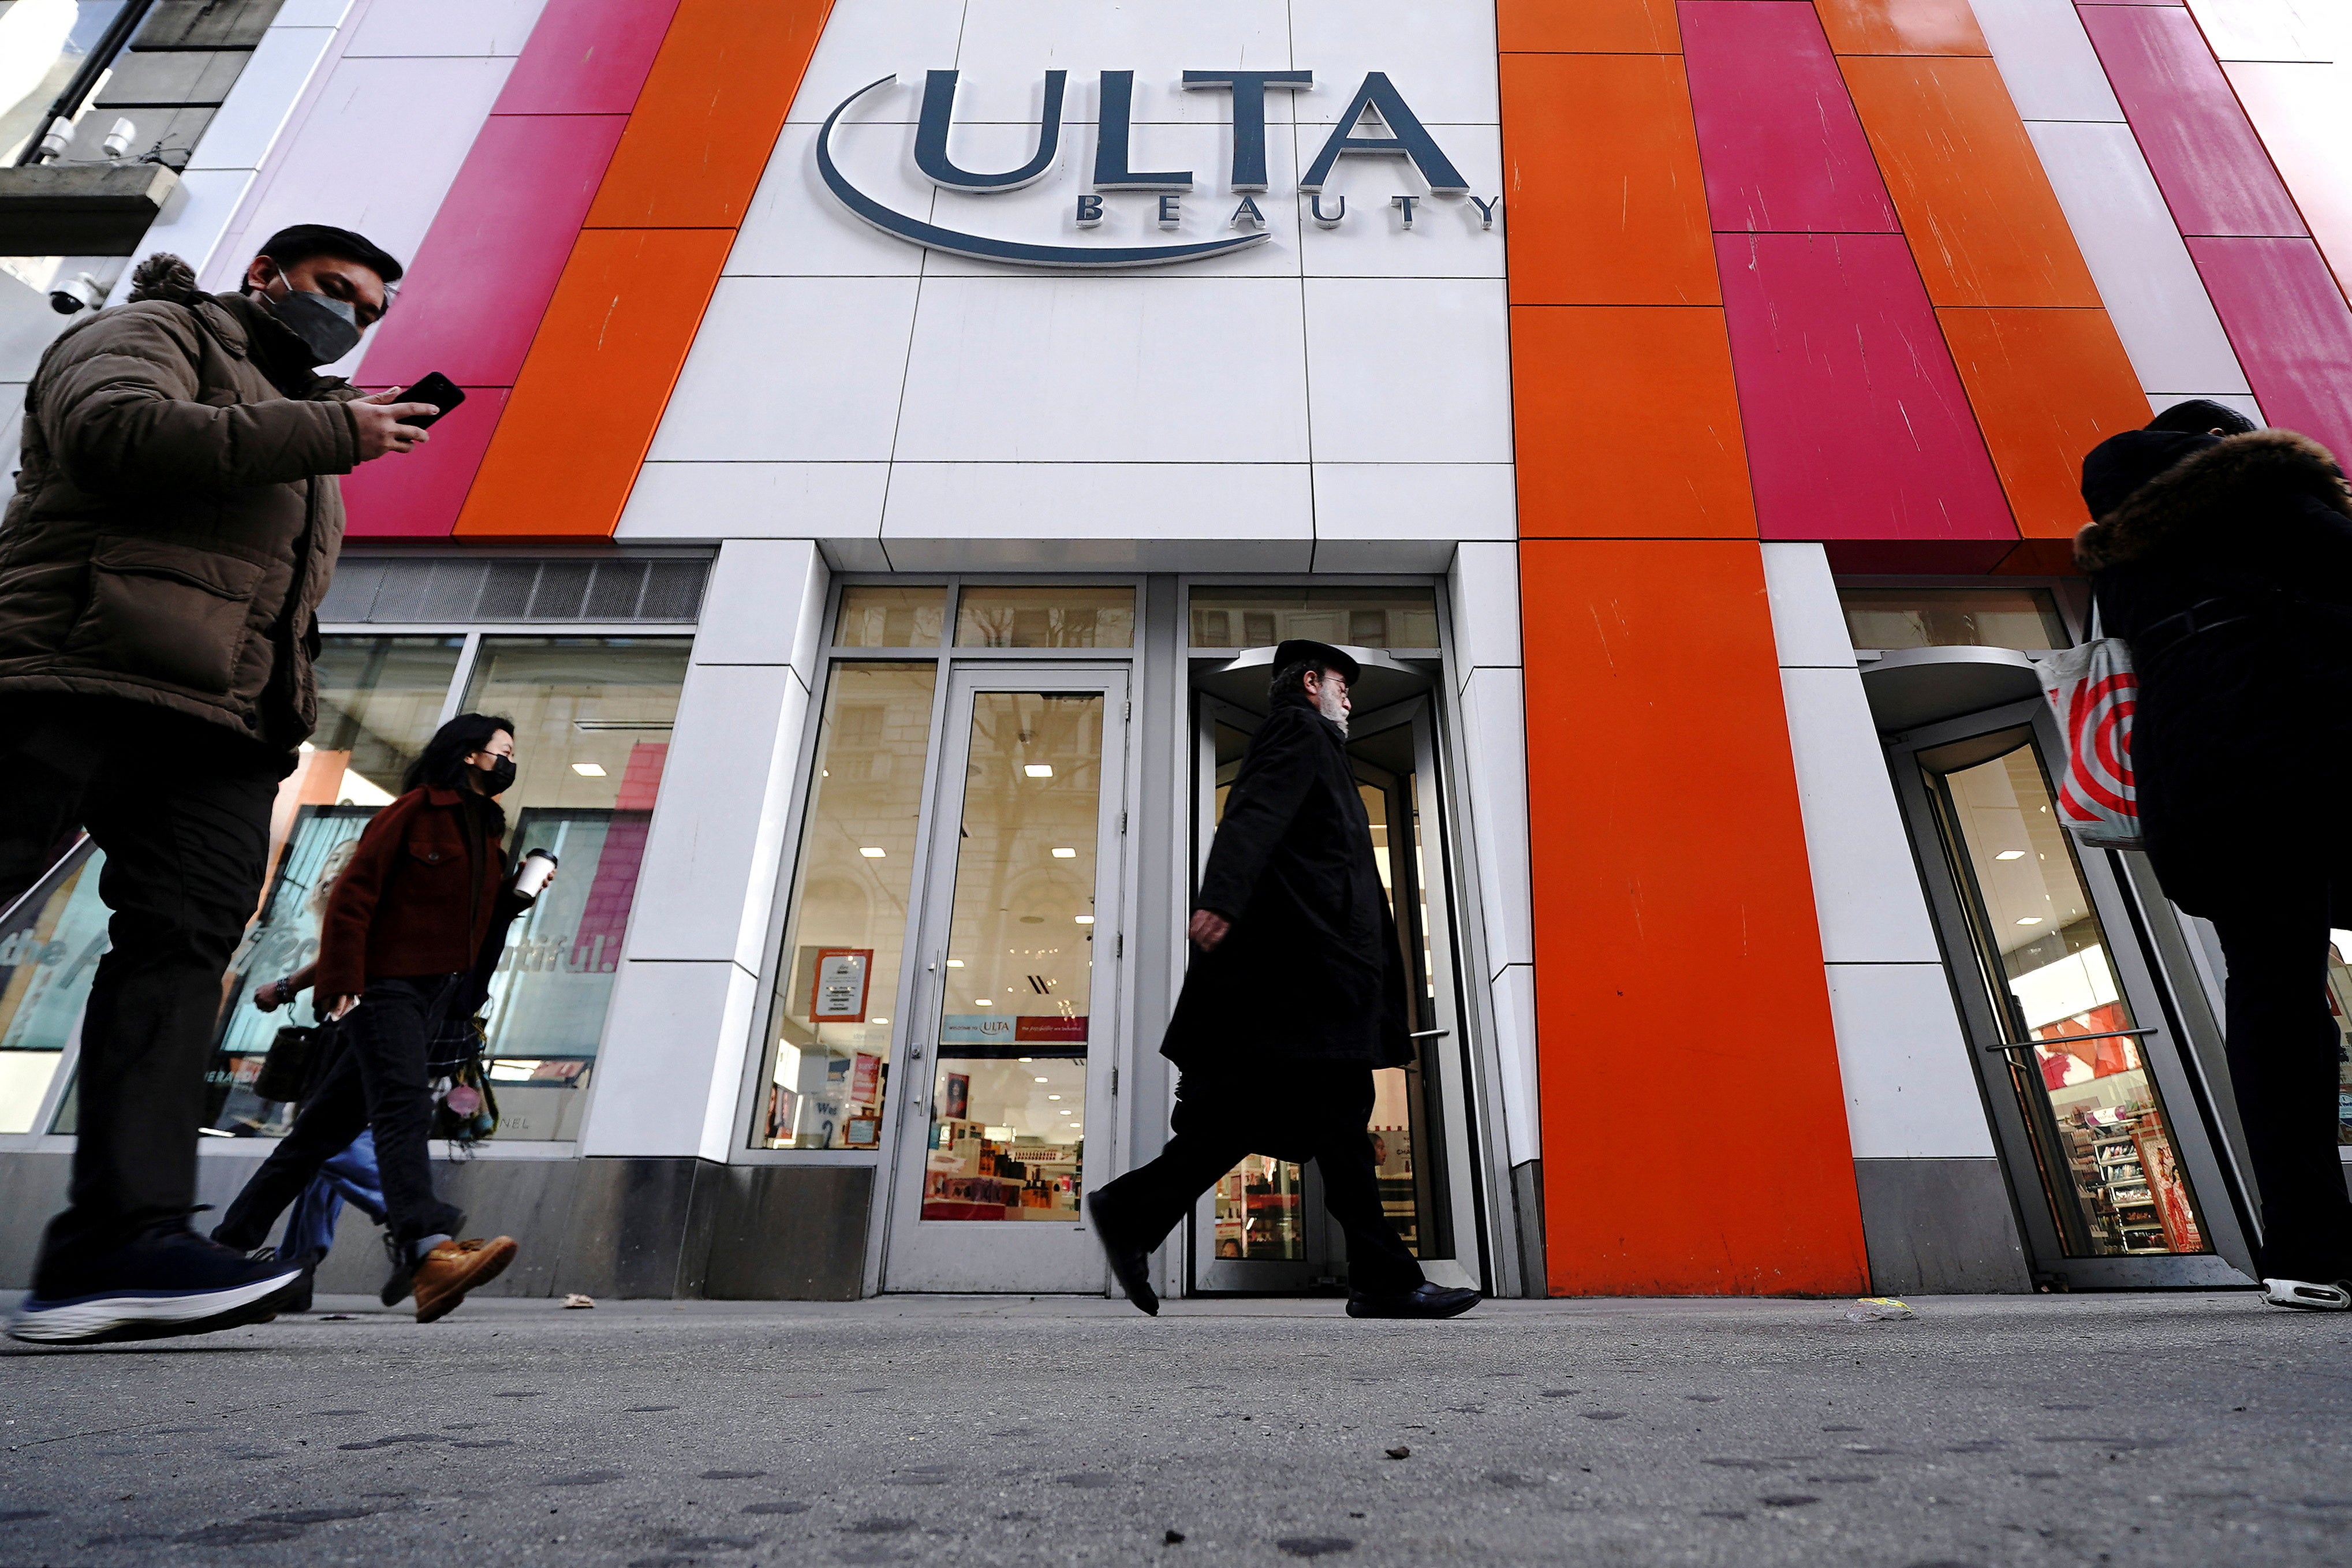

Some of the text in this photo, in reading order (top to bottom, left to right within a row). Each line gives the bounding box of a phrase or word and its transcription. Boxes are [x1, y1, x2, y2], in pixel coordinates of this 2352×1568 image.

[913, 69, 1471, 193] ULTA
[1076, 195, 1500, 230] BEAUTY
[983, 1021, 1009, 1031] ULTA
